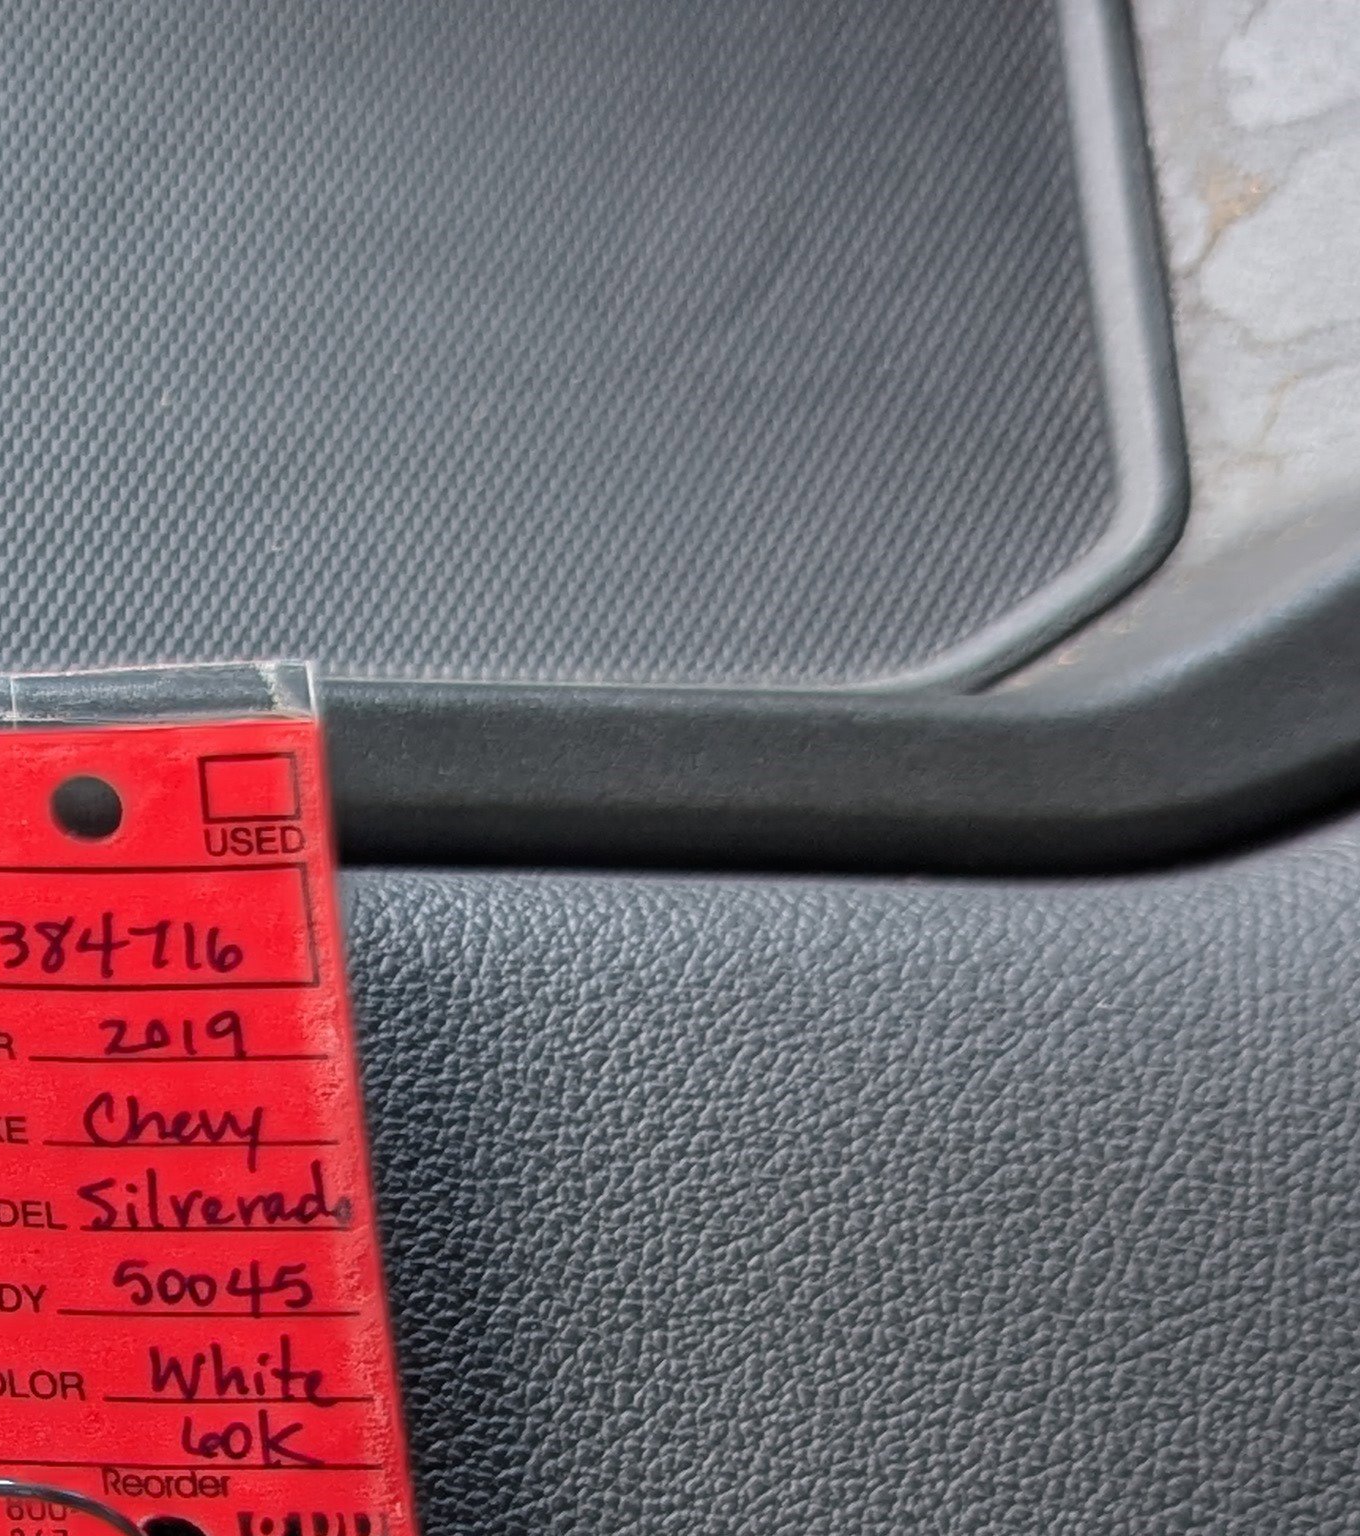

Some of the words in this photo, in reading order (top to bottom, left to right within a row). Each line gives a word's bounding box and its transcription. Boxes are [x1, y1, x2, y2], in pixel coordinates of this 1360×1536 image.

[204, 825, 306, 858] USED
[99, 1010, 248, 1061] 2019
[83, 1091, 264, 1173] Chevy
[112, 1259, 314, 1319] 50045
[148, 1333, 340, 1408] White
[101, 1467, 232, 1499] Reorder
